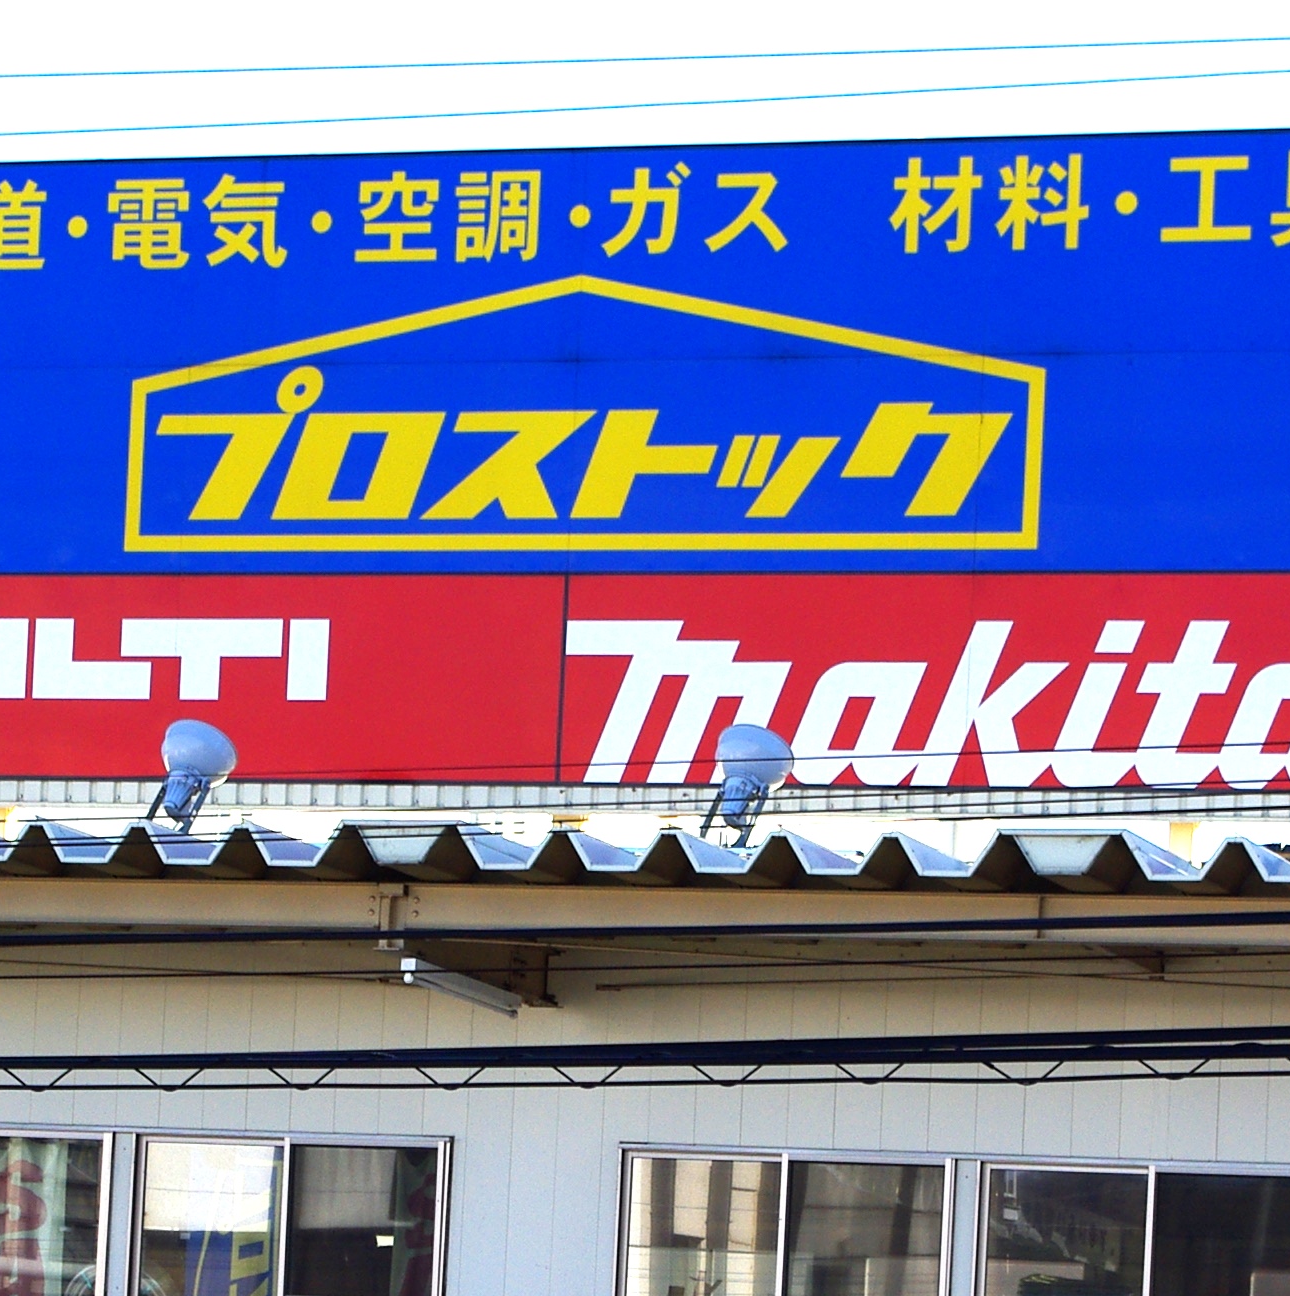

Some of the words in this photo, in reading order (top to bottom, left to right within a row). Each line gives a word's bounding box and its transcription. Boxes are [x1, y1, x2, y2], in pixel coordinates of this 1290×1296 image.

[155, 365, 1014, 520] プロストック
